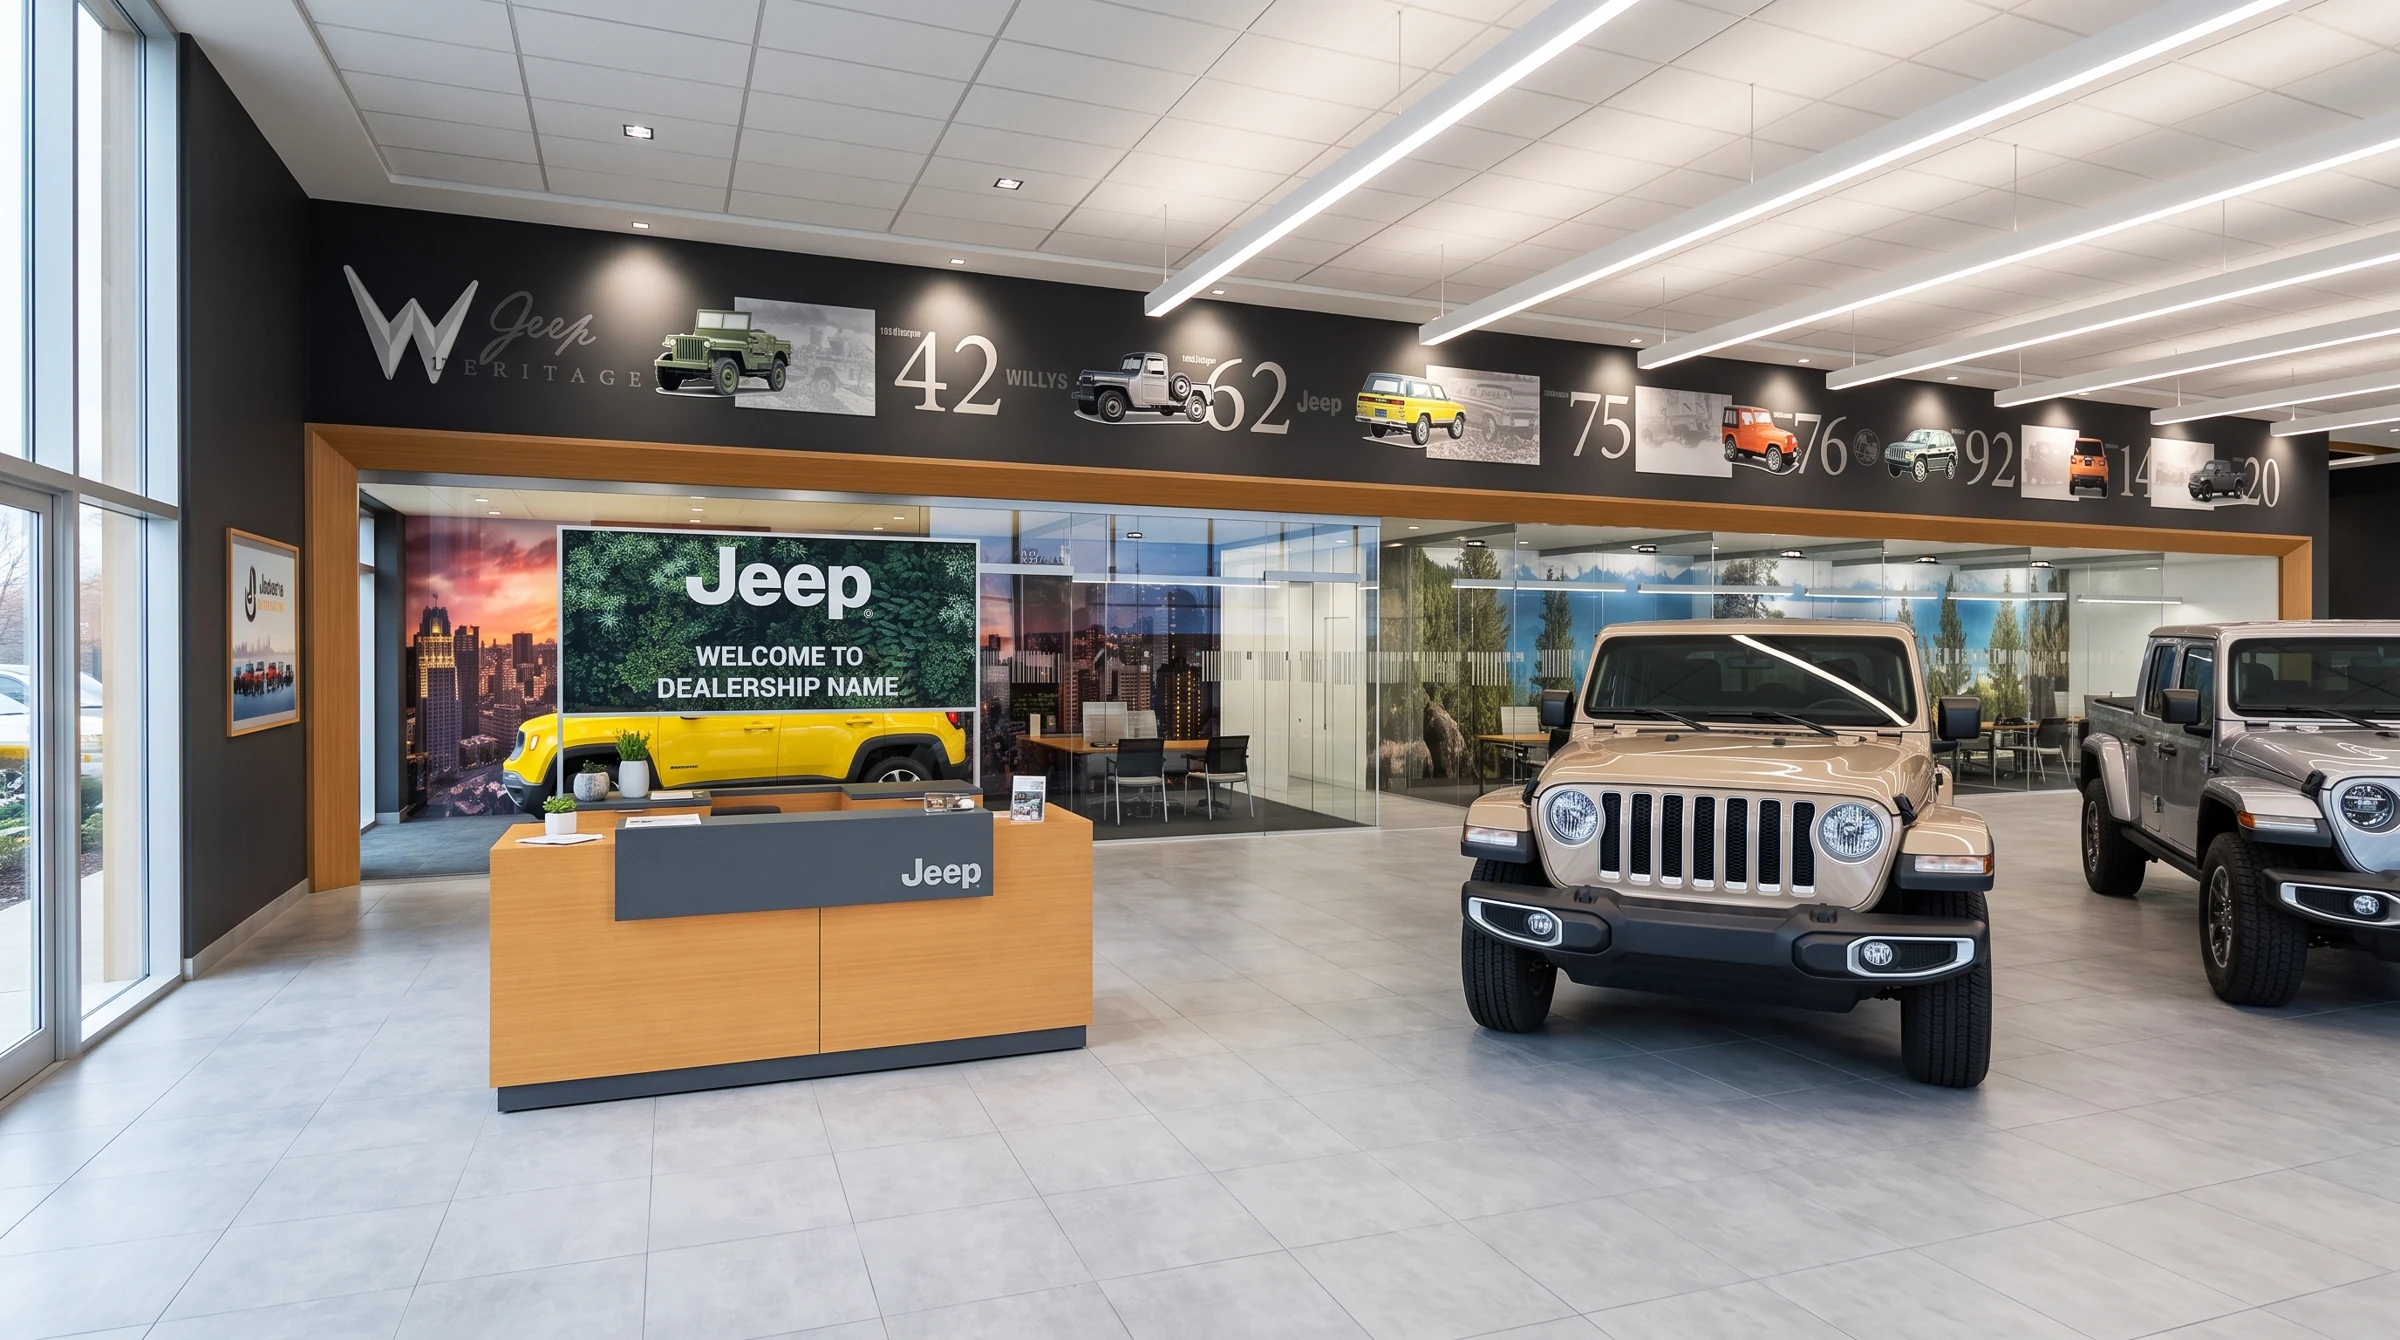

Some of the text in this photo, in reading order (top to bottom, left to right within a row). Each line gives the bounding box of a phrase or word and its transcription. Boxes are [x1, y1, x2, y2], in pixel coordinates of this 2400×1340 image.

[480, 290, 597, 366] Jeep
[894, 331, 1001, 415] 42
[1006, 368, 1068, 390] WILLYS
[1206, 358, 1290, 435] 62
[1296, 389, 1342, 416] Jeep
[1570, 391, 1631, 459] 75
[1795, 412, 1848, 476] 76
[1965, 429, 2016, 488] 92
[2244, 456, 2280, 508] 20
[685, 546, 872, 620] Jeep
[695, 645, 863, 667] WELCOME TO
[657, 676, 899, 699] DEALERSHIP NAME
[901, 857, 982, 889] Jeep
